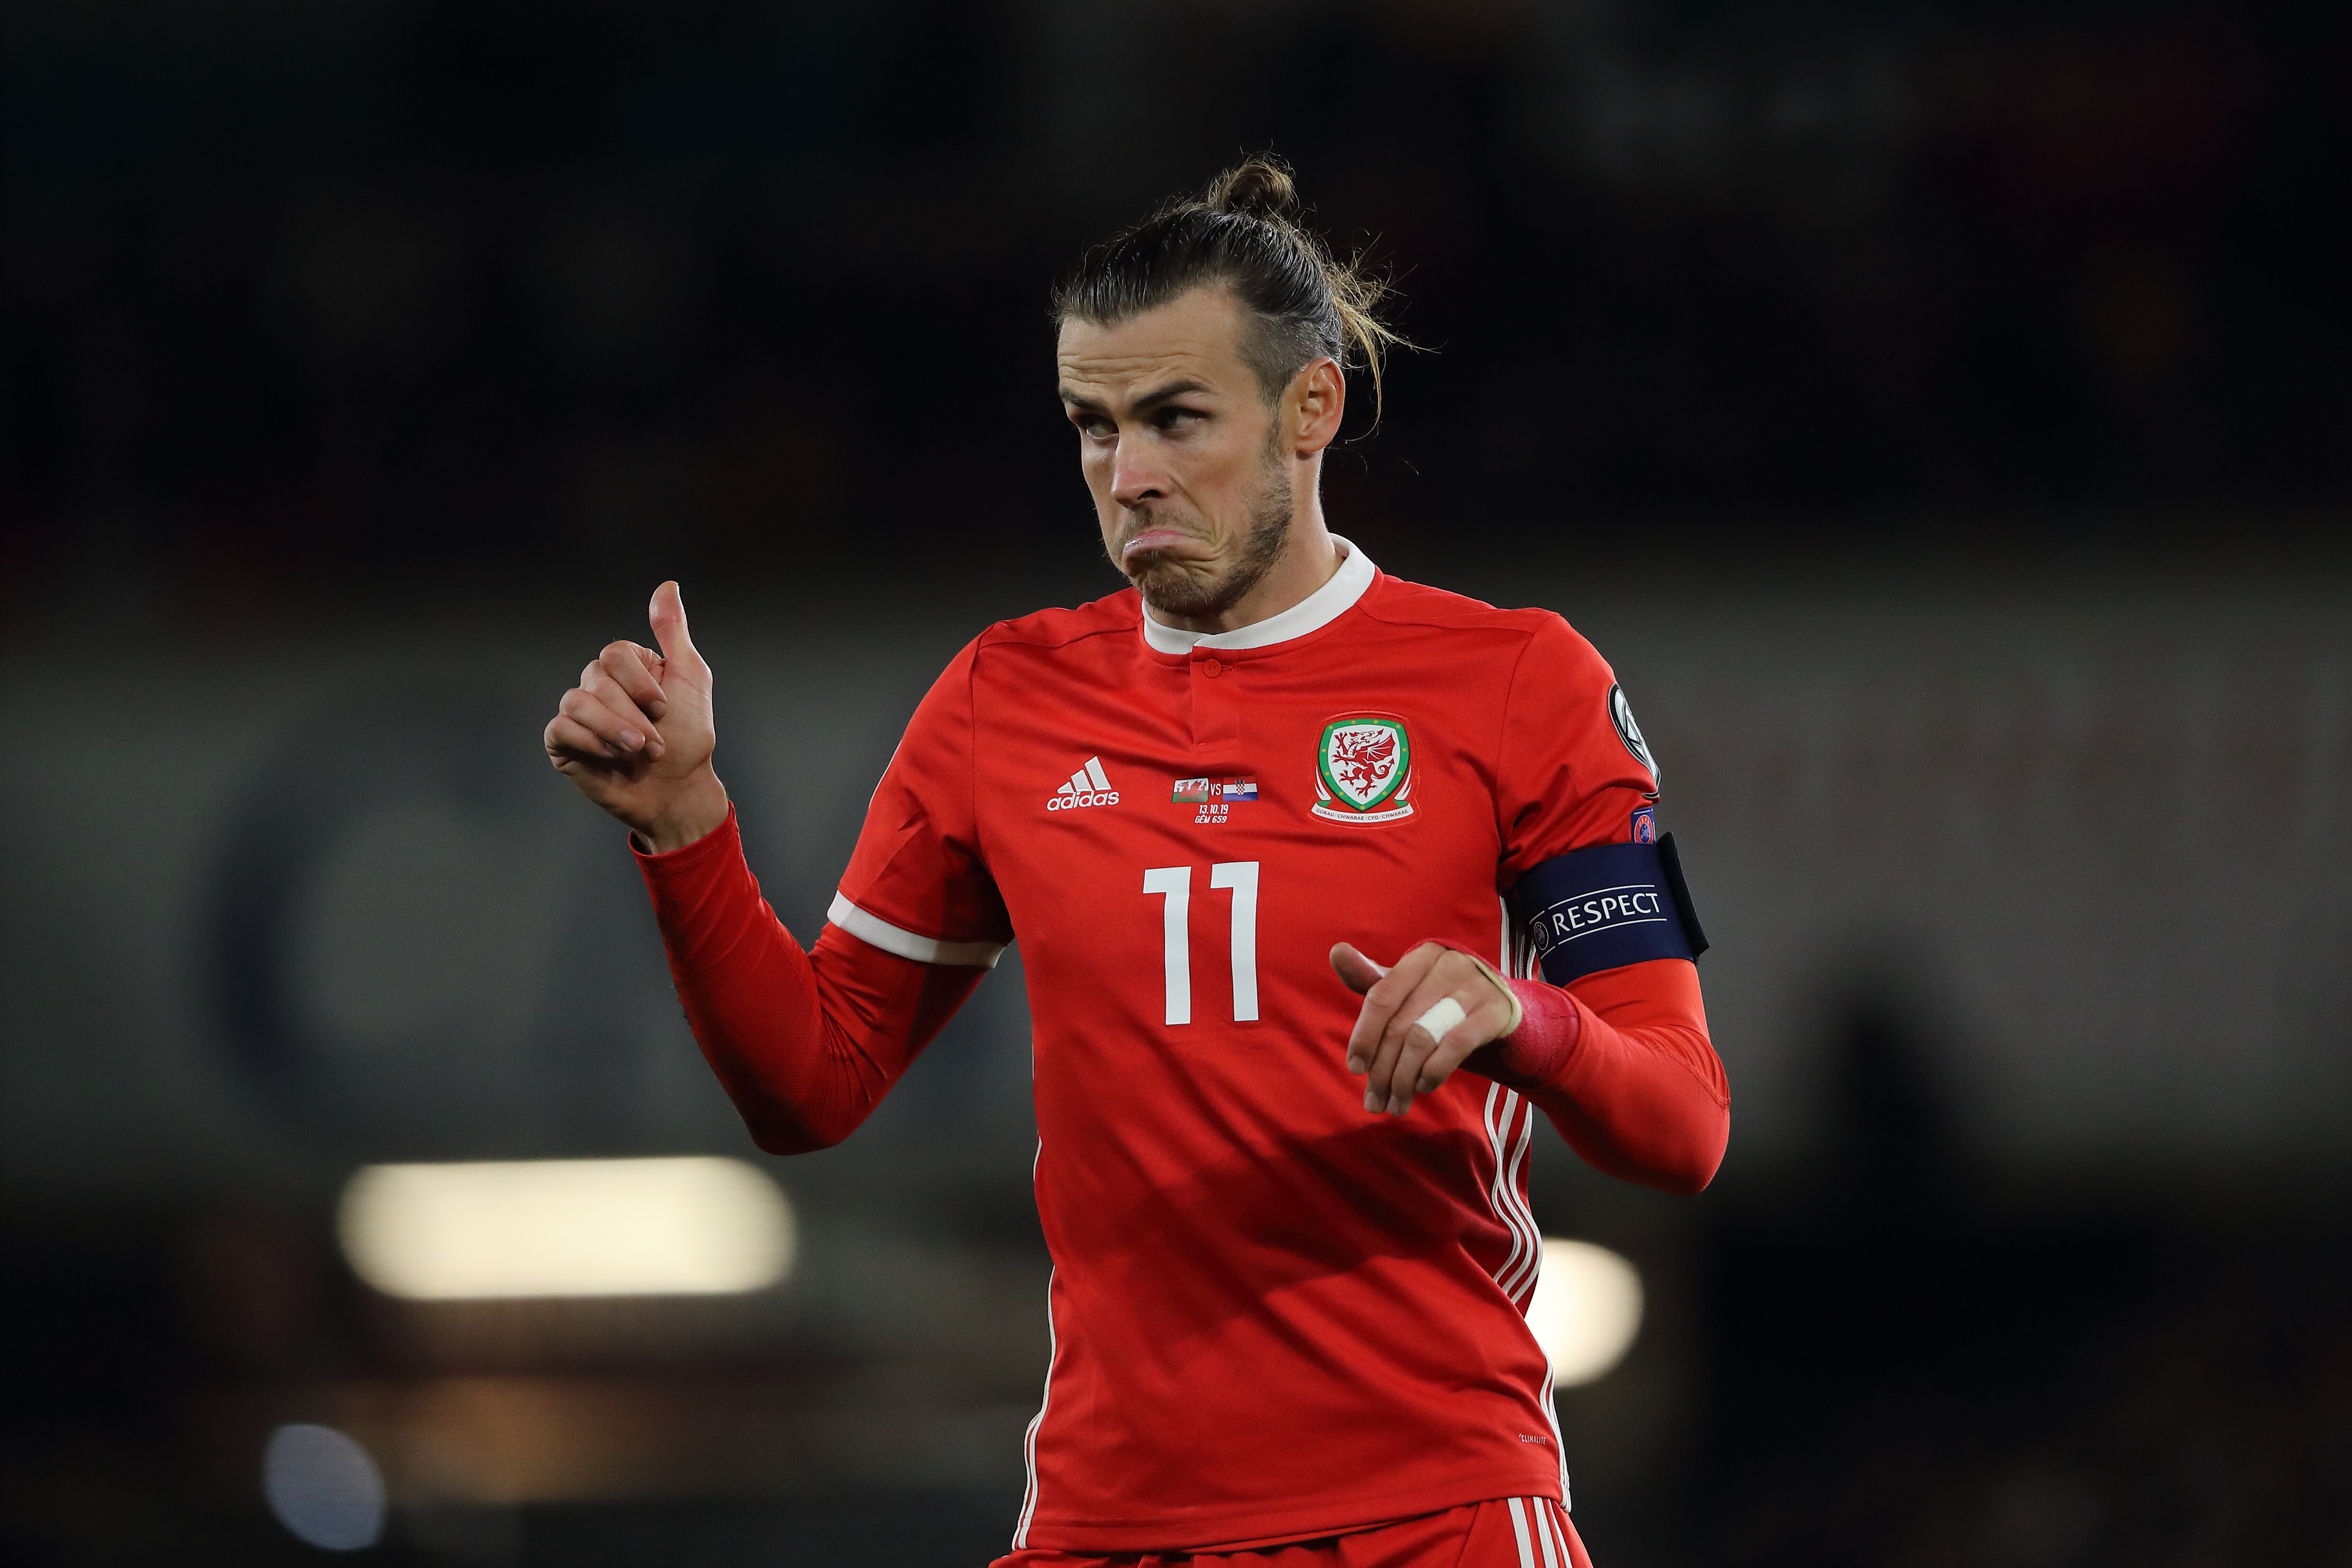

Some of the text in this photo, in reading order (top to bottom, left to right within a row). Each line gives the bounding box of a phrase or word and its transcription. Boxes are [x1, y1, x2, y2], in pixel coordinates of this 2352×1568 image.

[1210, 783, 1222, 796] VS
[1047, 791, 1120, 811] adidas
[1199, 804, 1229, 814] 13.10.19
[1316, 808, 1334, 817] GORAU
[1382, 809, 1409, 819] CHWARAE
[1194, 814, 1227, 824] GÊM 659
[1638, 817, 1650, 826] UEFA
[1552, 893, 1660, 936] RESPECT
[1142, 861, 1259, 1026] 11
